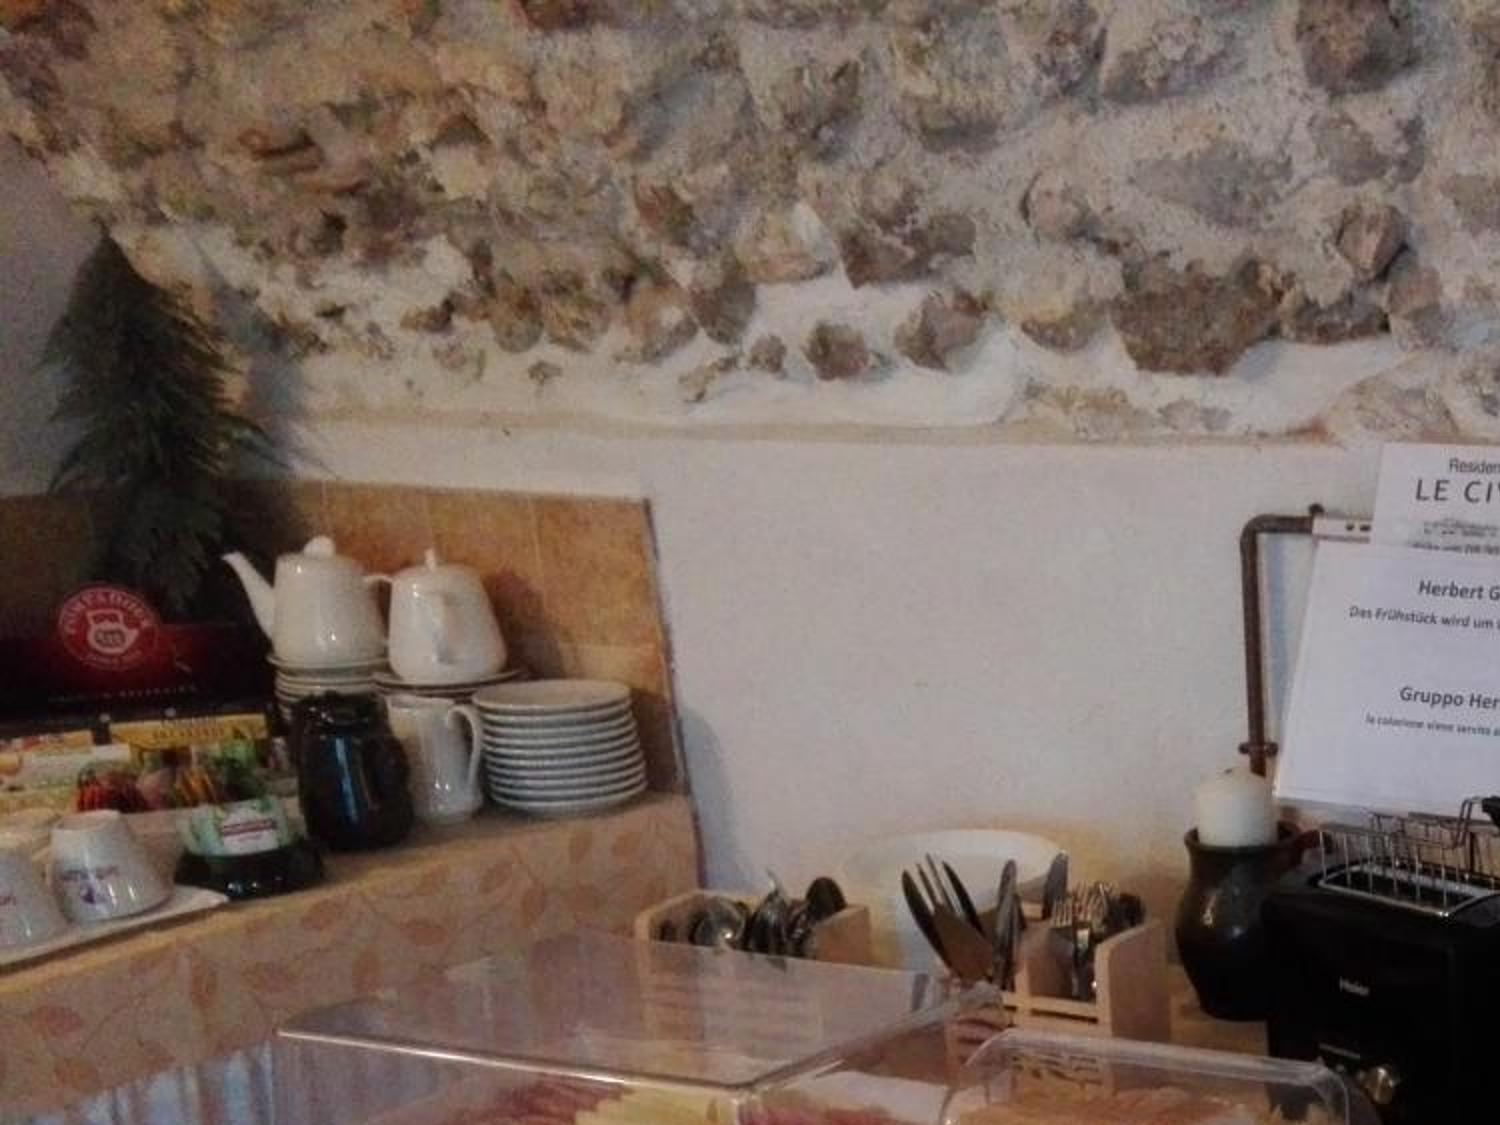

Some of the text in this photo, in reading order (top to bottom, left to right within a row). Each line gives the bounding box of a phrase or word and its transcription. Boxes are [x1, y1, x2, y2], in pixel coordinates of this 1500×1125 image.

[1415, 479, 1450, 501] LE
[1418, 579, 1484, 600] Herbert
[1349, 605, 1372, 619] Das
[1375, 606, 1438, 625] Frühstück
[1441, 613, 1470, 628] wird
[1473, 618, 1494, 630] um
[1399, 686, 1464, 708] Gruppo
